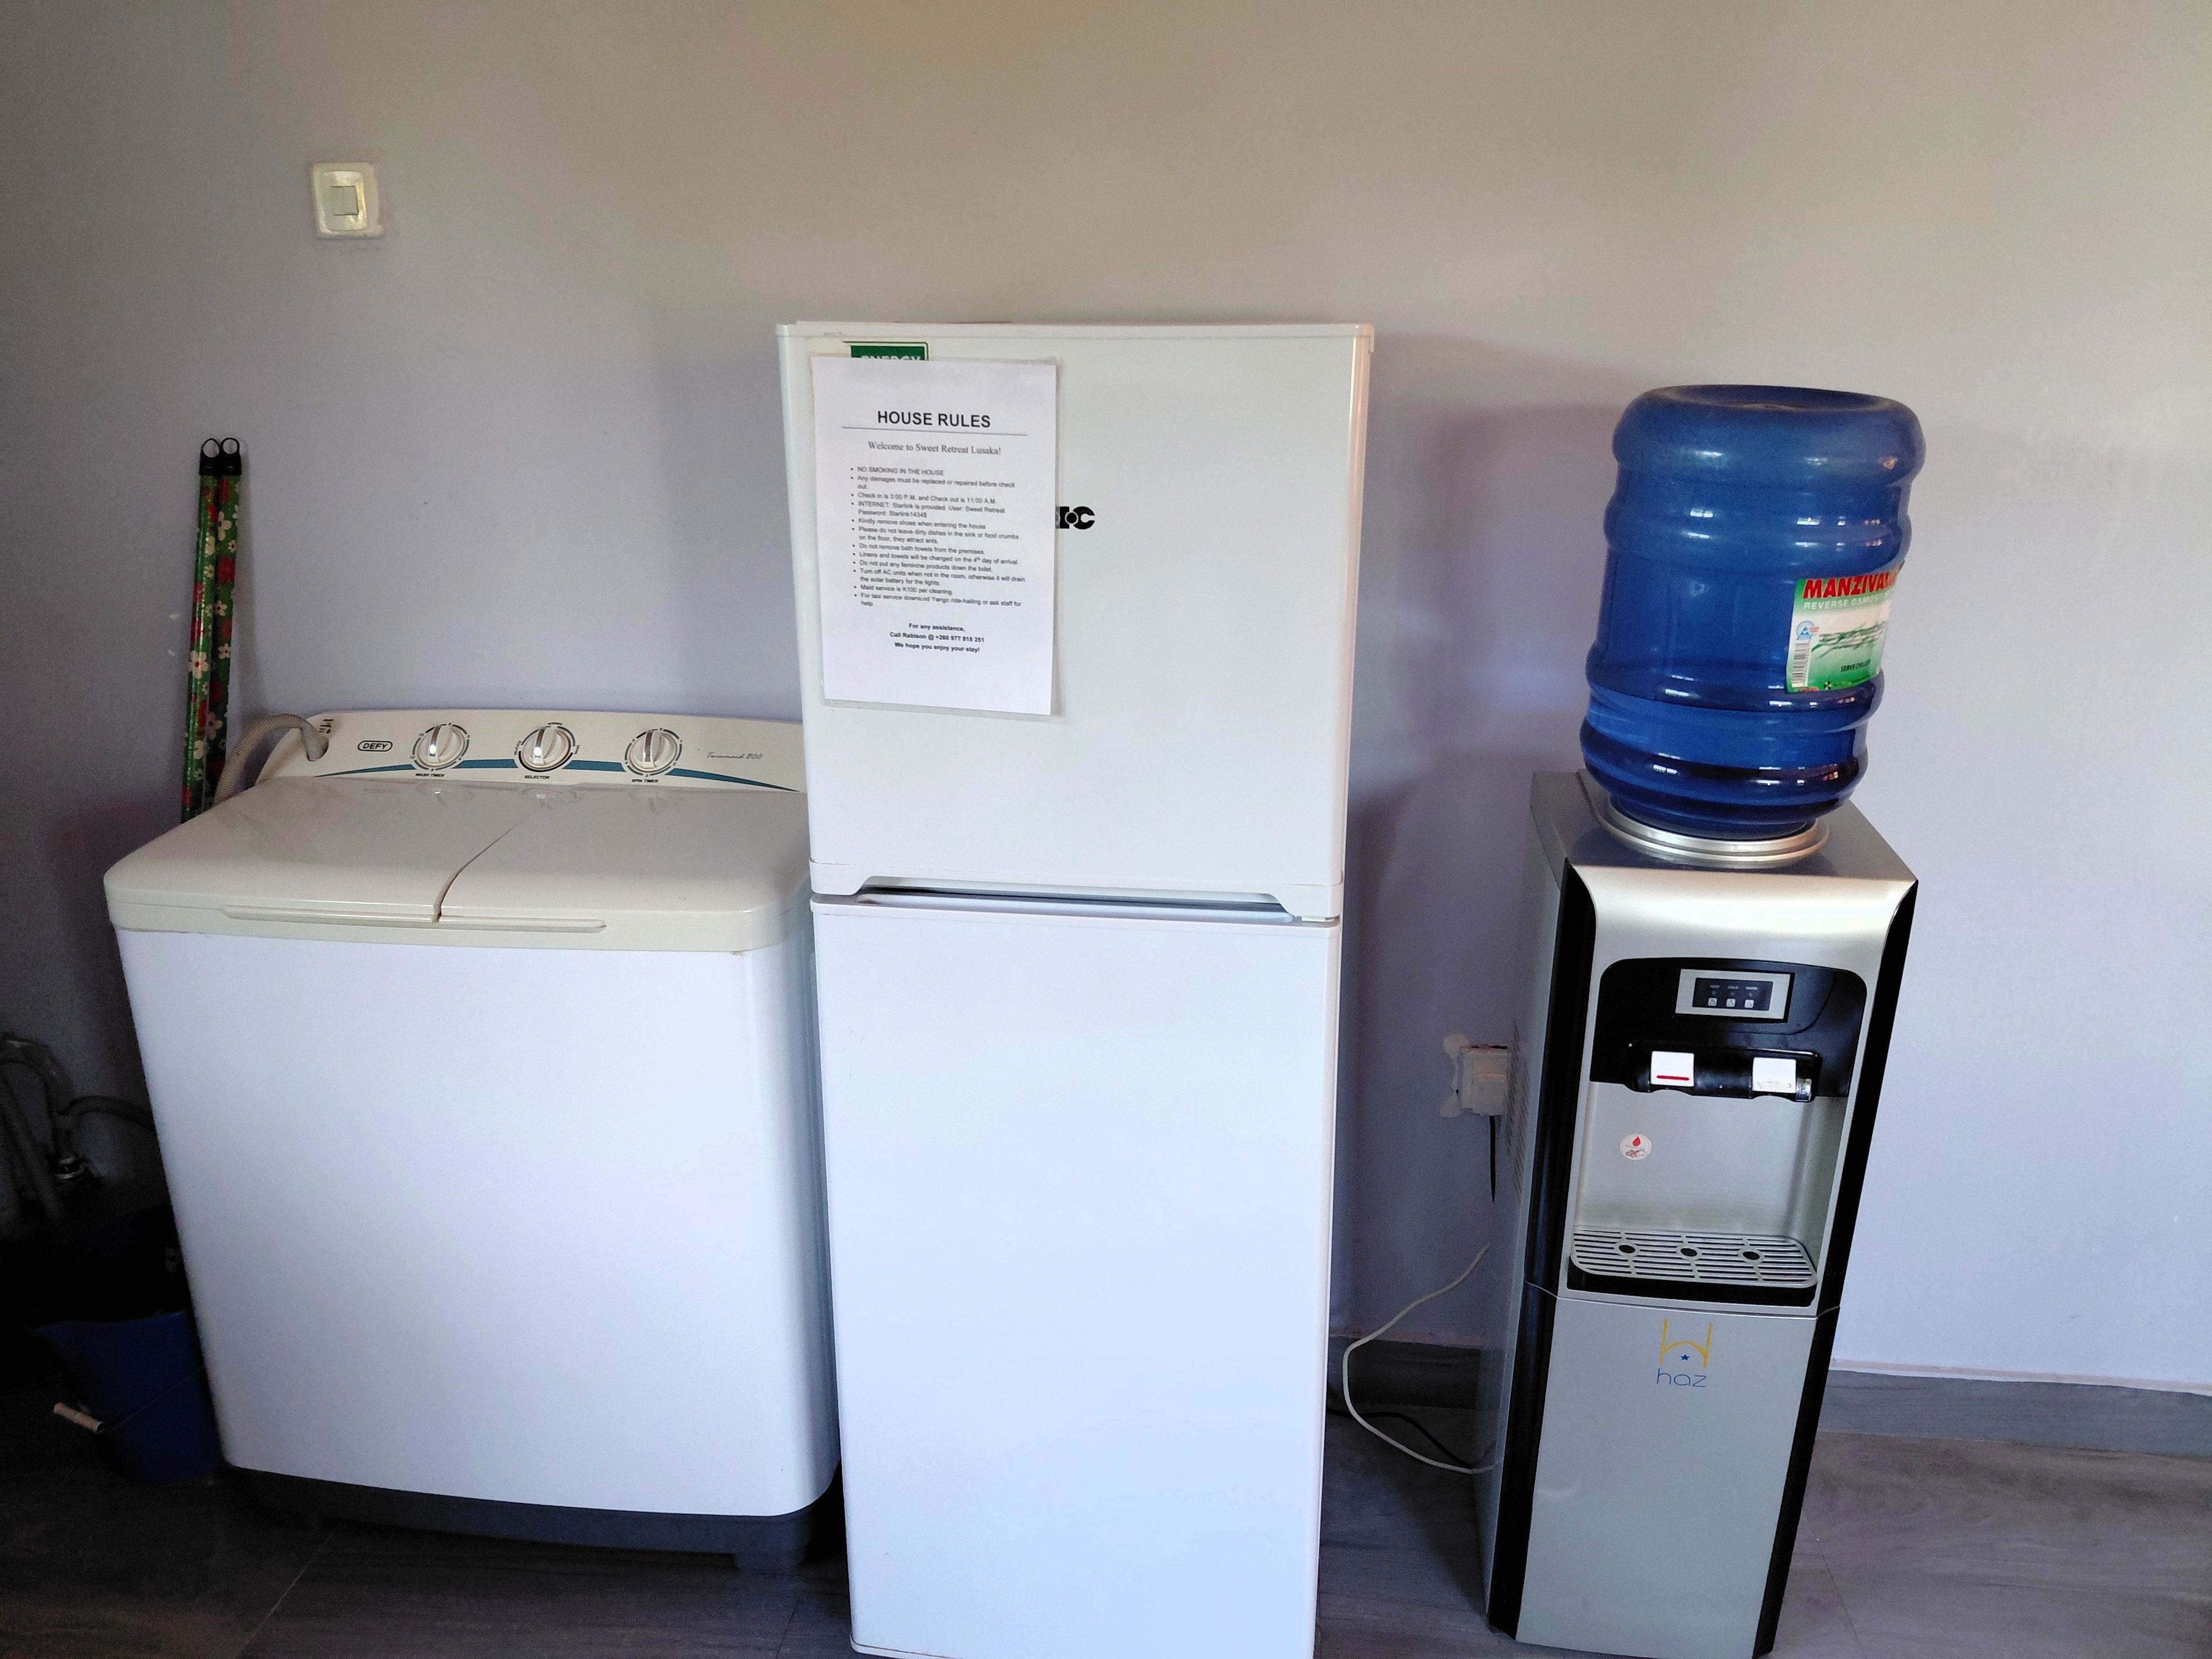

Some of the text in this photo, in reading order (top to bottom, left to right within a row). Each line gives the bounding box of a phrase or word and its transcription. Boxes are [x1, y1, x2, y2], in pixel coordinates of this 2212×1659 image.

[877, 411, 991, 428] HOUSE RULES
[868, 441, 904, 450] Welcome
[915, 444, 939, 452] Sweet
[941, 445, 968, 453] Retreat
[971, 446, 1001, 455] Lusaka!
[933, 521, 957, 529] entering
[1804, 599, 1849, 610] REVERSE
[1657, 1368, 1707, 1388] haz
